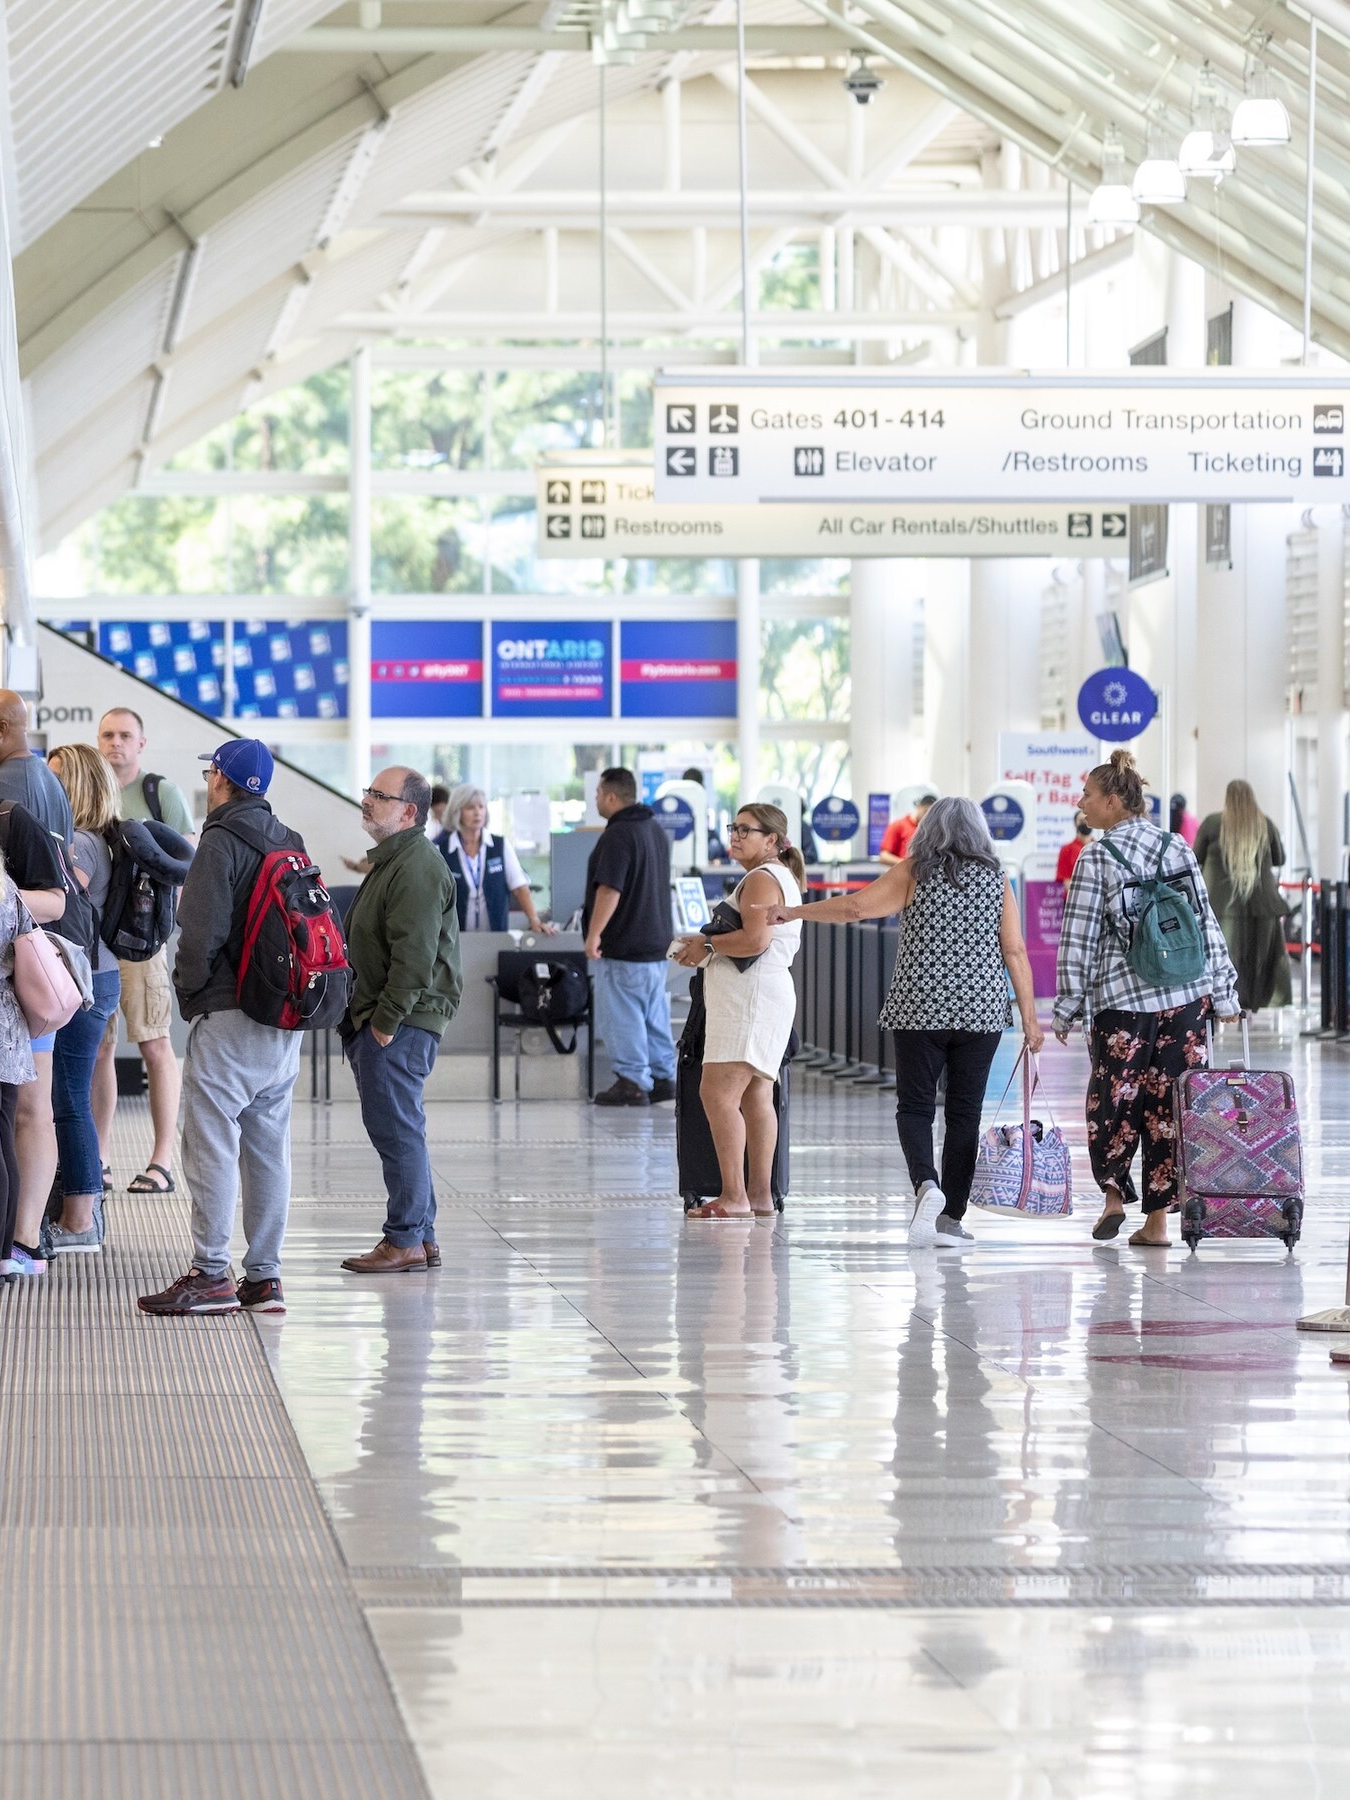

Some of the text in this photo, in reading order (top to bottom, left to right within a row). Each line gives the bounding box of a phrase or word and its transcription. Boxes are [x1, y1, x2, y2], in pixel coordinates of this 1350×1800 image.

[750, 409, 946, 430] Gates 401-414
[1020, 409, 1303, 434] Ground Transportation
[835, 451, 1149, 473] Elevator /Restrooms
[1188, 451, 1303, 478] Ticketing
[614, 518, 723, 535] Restrooms
[818, 517, 1059, 536] All Car Rentals/Shuttles
[497, 639, 605, 660] ONTARIO
[1090, 710, 1142, 725] CLEAR
[1027, 744, 1088, 755] Southwest
